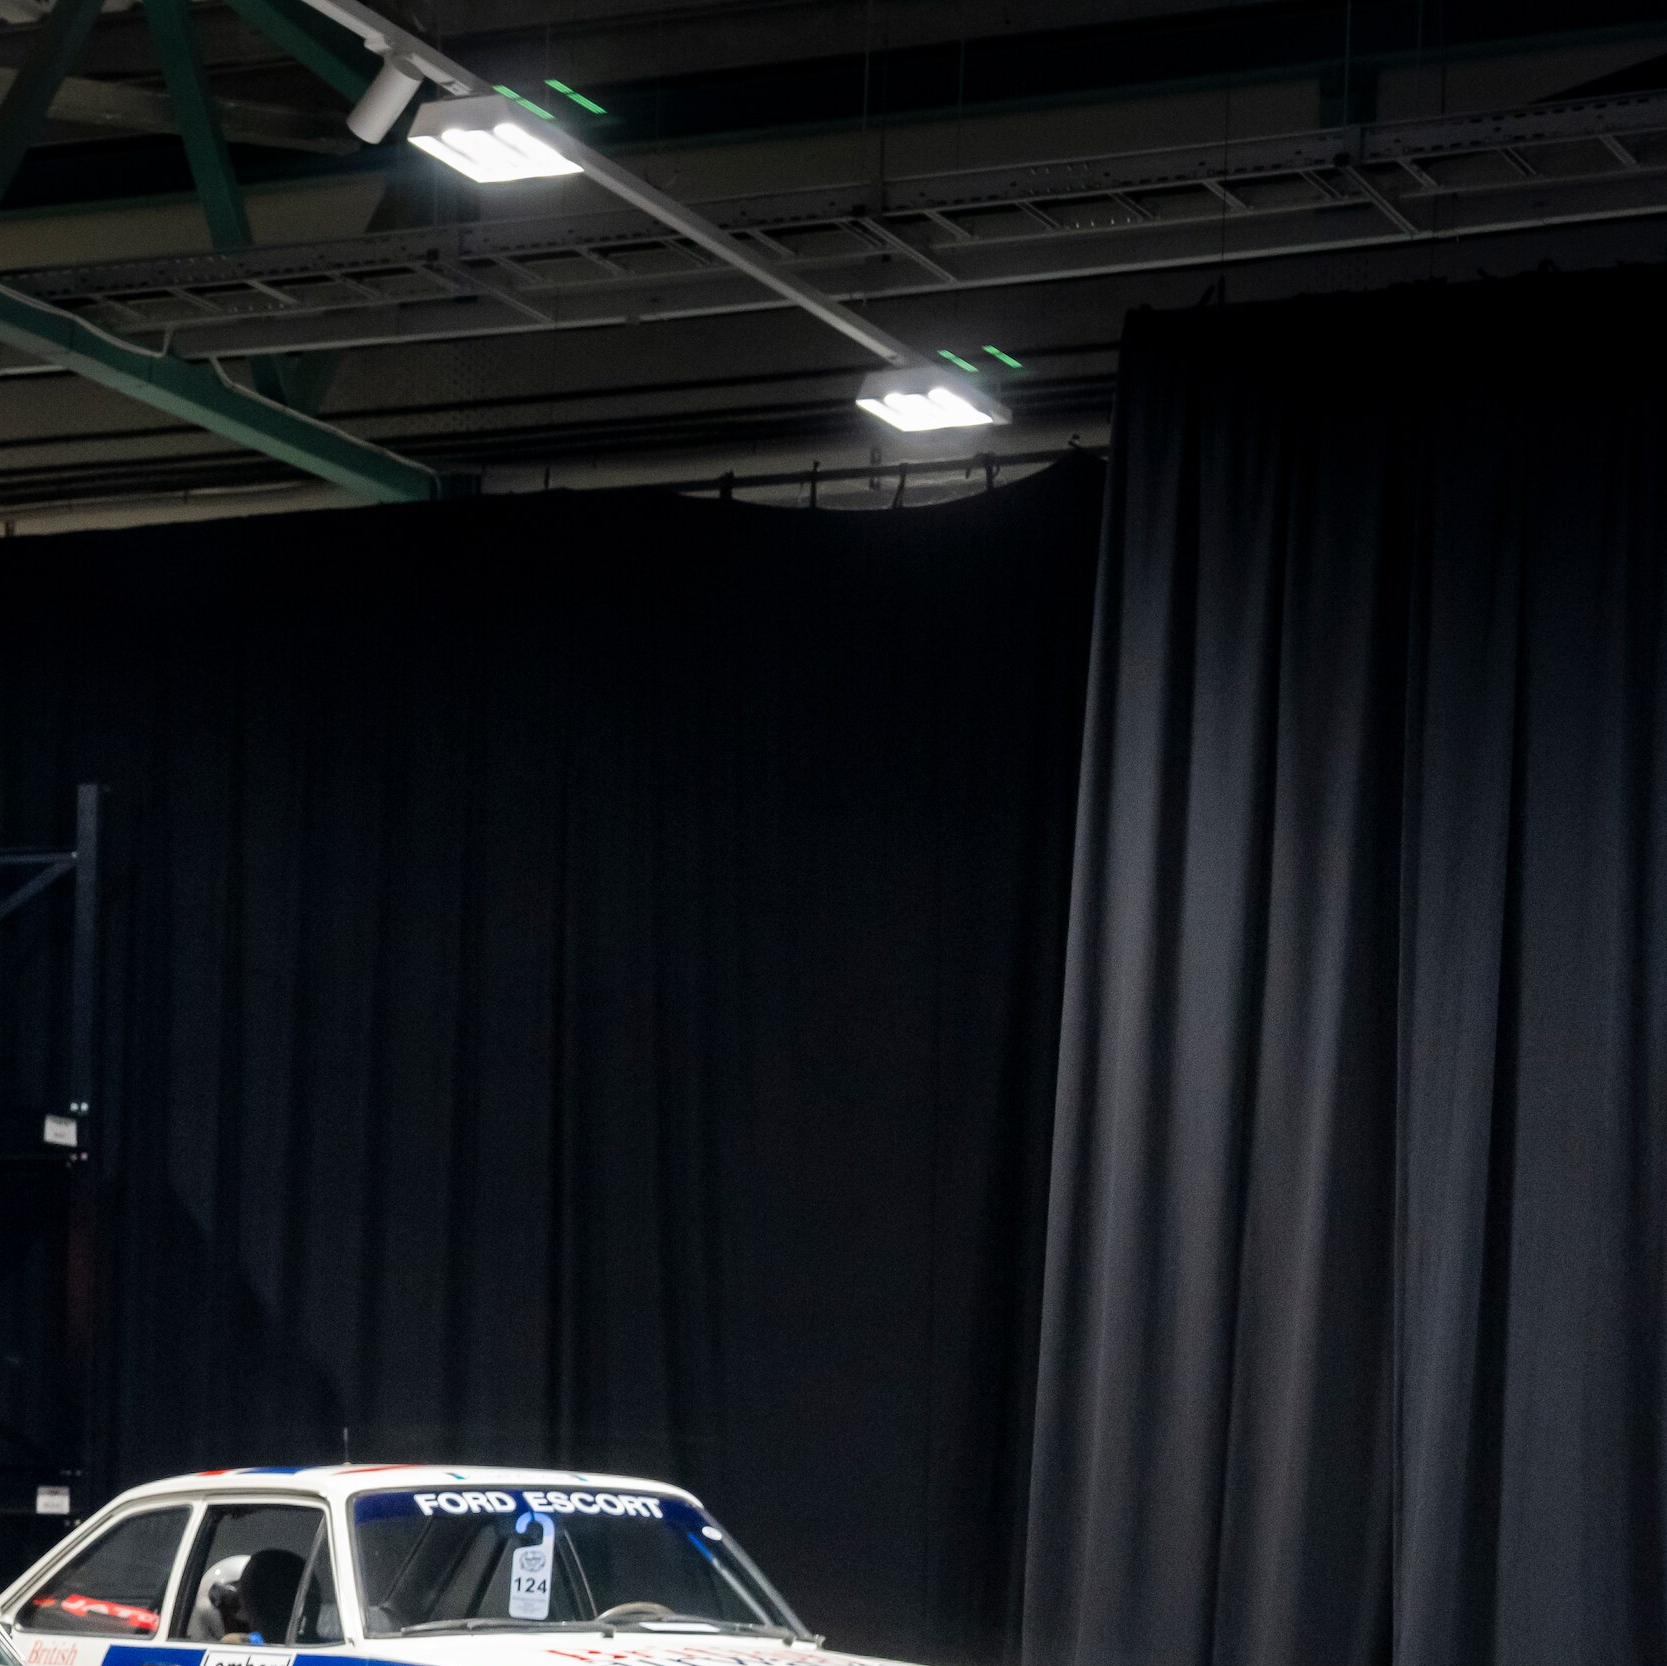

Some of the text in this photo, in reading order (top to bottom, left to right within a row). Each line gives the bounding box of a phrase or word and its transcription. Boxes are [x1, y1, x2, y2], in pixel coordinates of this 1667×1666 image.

[414, 1491, 664, 1518] FORD ESCORT
[515, 1577, 547, 1594] 124
[28, 1639, 78, 1666] British
